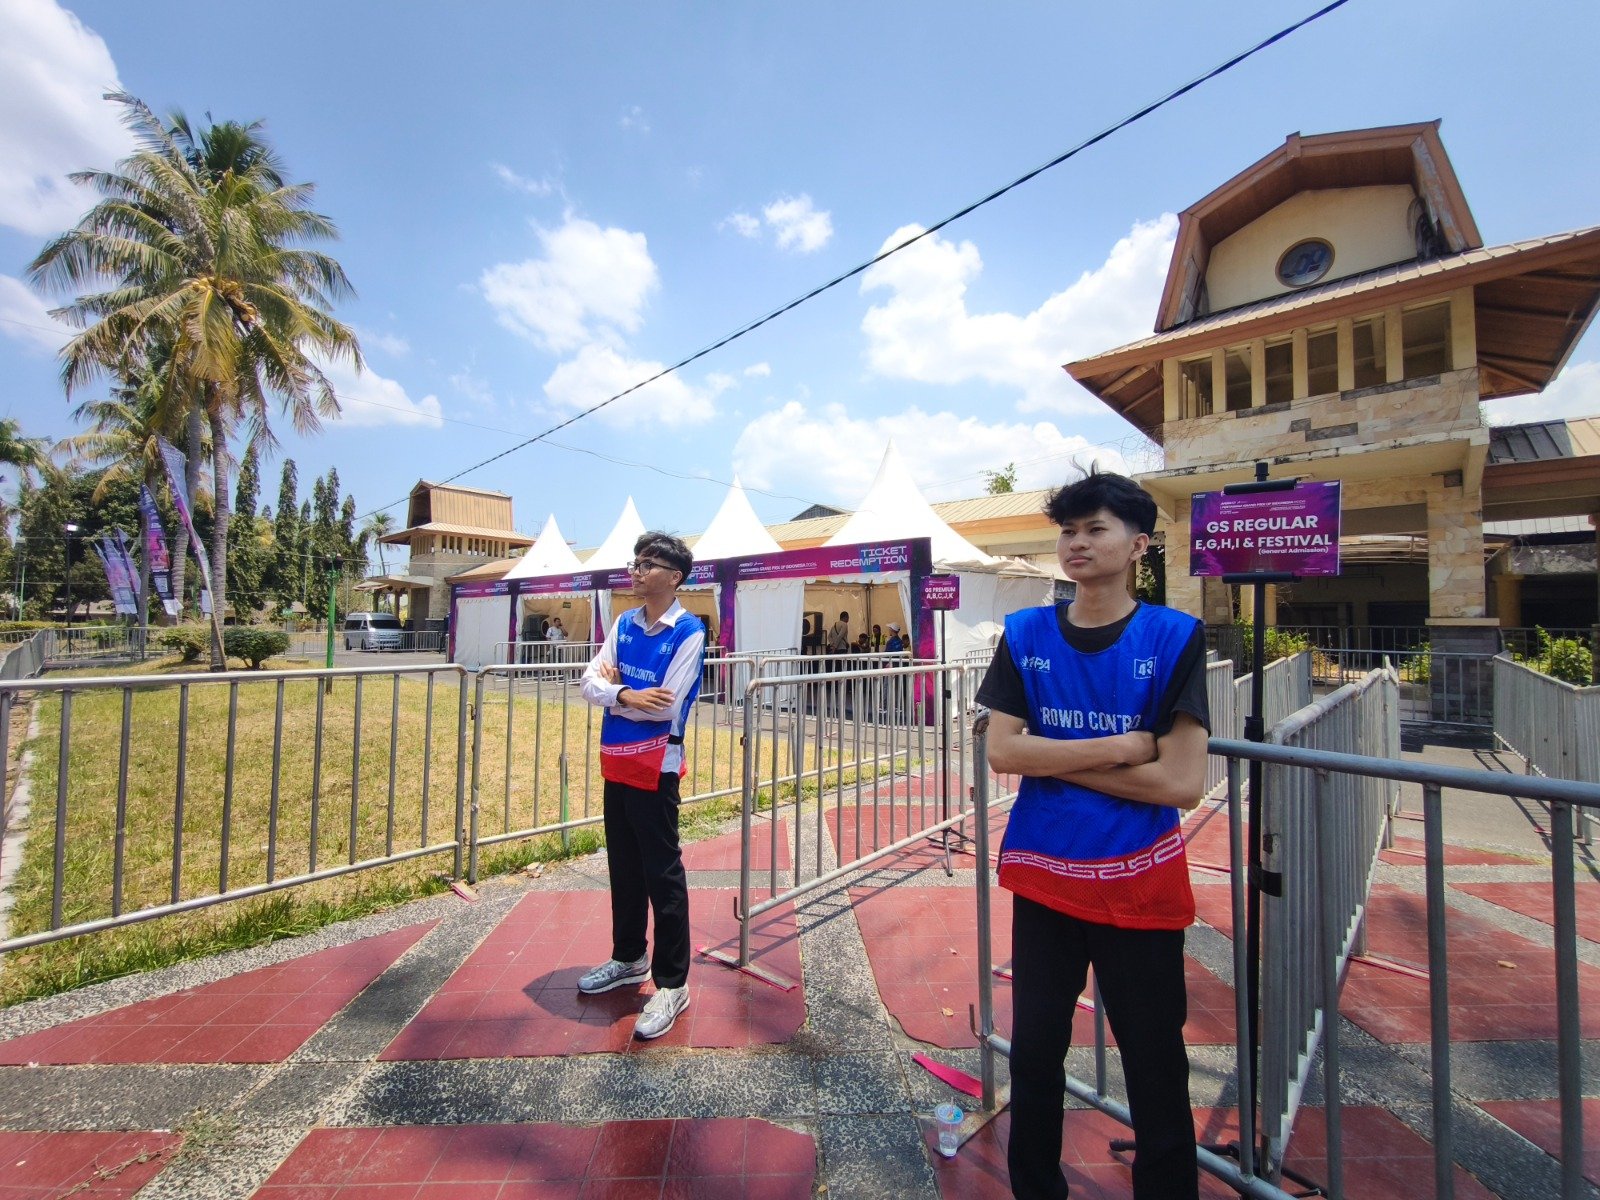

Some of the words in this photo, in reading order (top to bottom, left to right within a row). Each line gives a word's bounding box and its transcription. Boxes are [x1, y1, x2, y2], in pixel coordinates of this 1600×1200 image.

[1206, 520, 1230, 533] GS
[1233, 515, 1318, 532] REGULAR
[1195, 537, 1240, 551] E,G,H,I
[1243, 537, 1254, 548] &
[1258, 534, 1332, 547] FESTIVAL
[860, 545, 907, 558] TICKET
[1258, 547, 1287, 556] (General
[1288, 546, 1329, 555] Admission)
[690, 564, 714, 573] ICKET
[829, 554, 907, 569] REDEMPTION
[1040, 706, 1084, 729] ROWD
